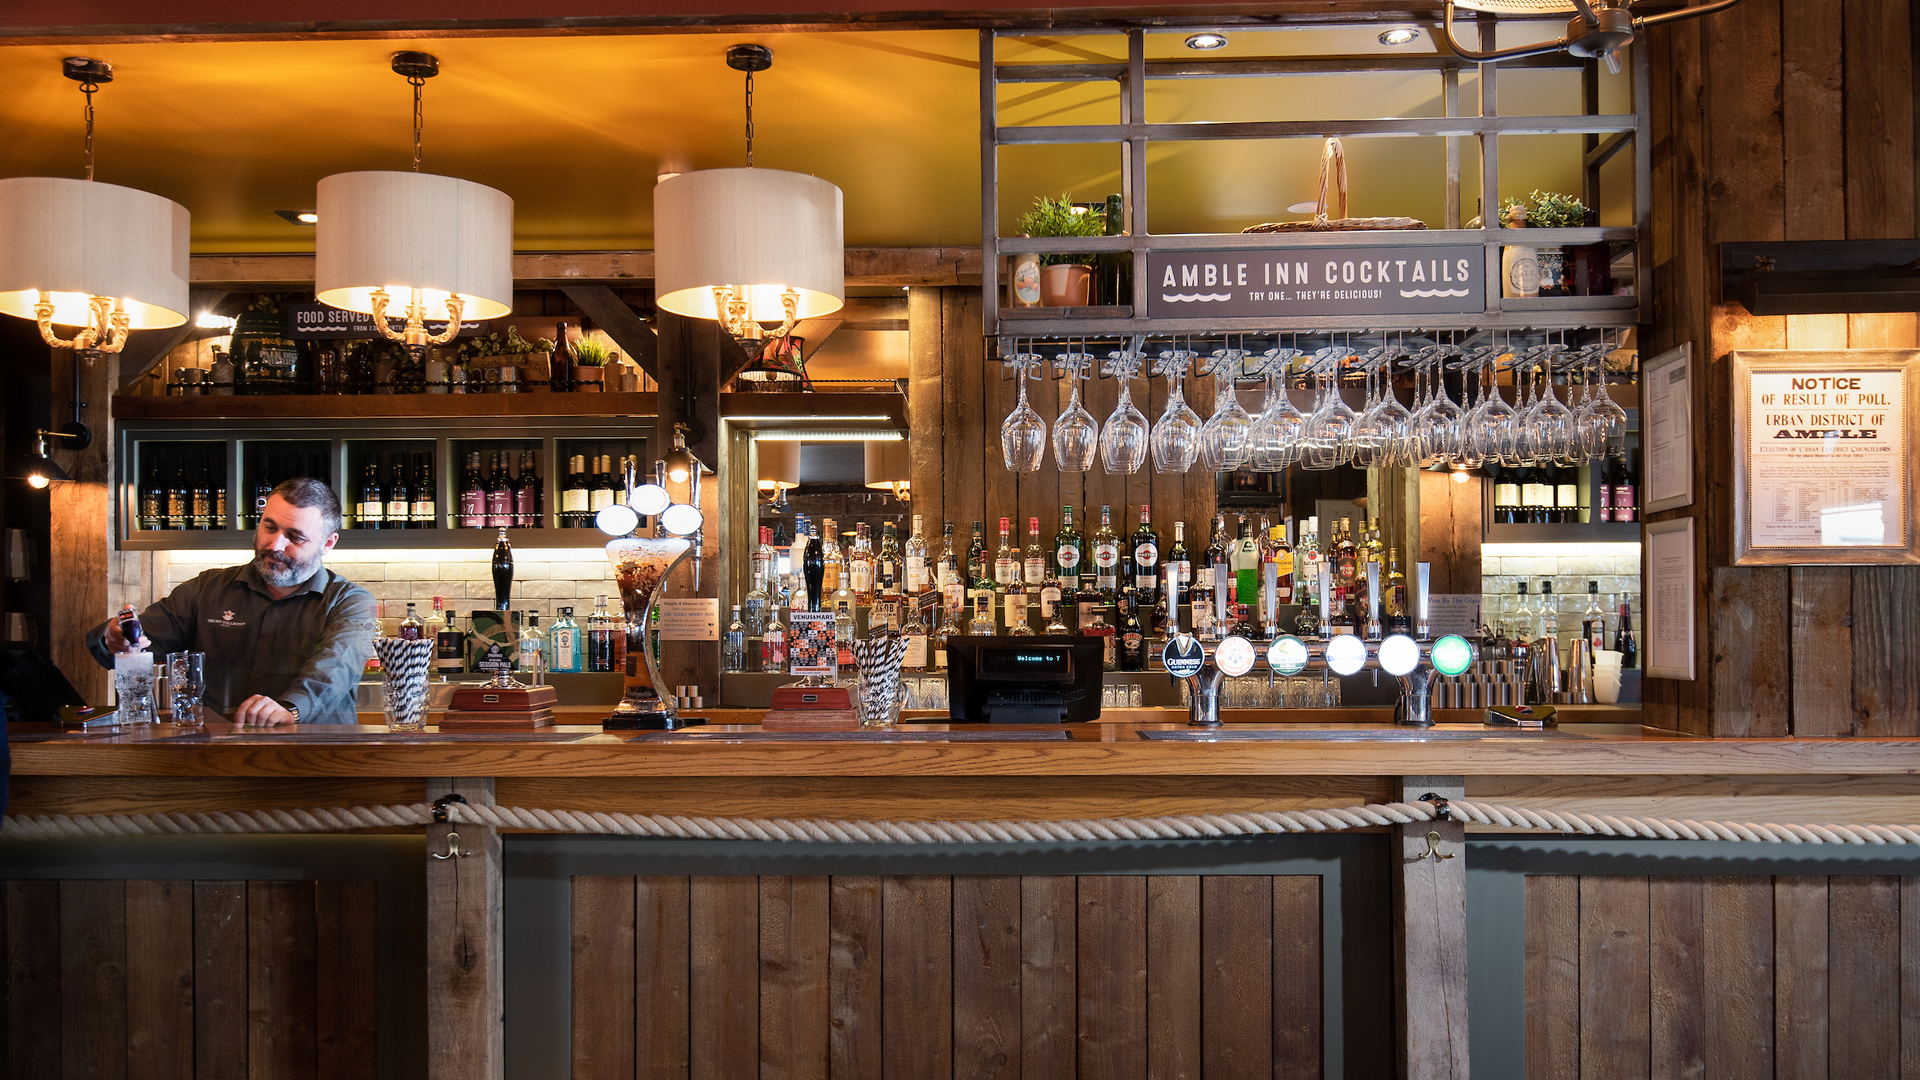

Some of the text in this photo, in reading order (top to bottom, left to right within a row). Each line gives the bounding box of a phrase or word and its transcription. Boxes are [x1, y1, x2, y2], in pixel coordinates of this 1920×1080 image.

[1162, 258, 1470, 288] AMBLE INN COCKTAILS
[1249, 289, 1382, 301] TRY ONE... THEY'RE DELICIOUS!
[297, 310, 370, 323] FOOD SERVED
[1792, 377, 1861, 390] NOTICE
[1761, 393, 1891, 405] OF RESULT OF POLL.
[1766, 414, 1886, 426] URBAN DISTRICT OF
[1773, 429, 1877, 439] AMBLE
